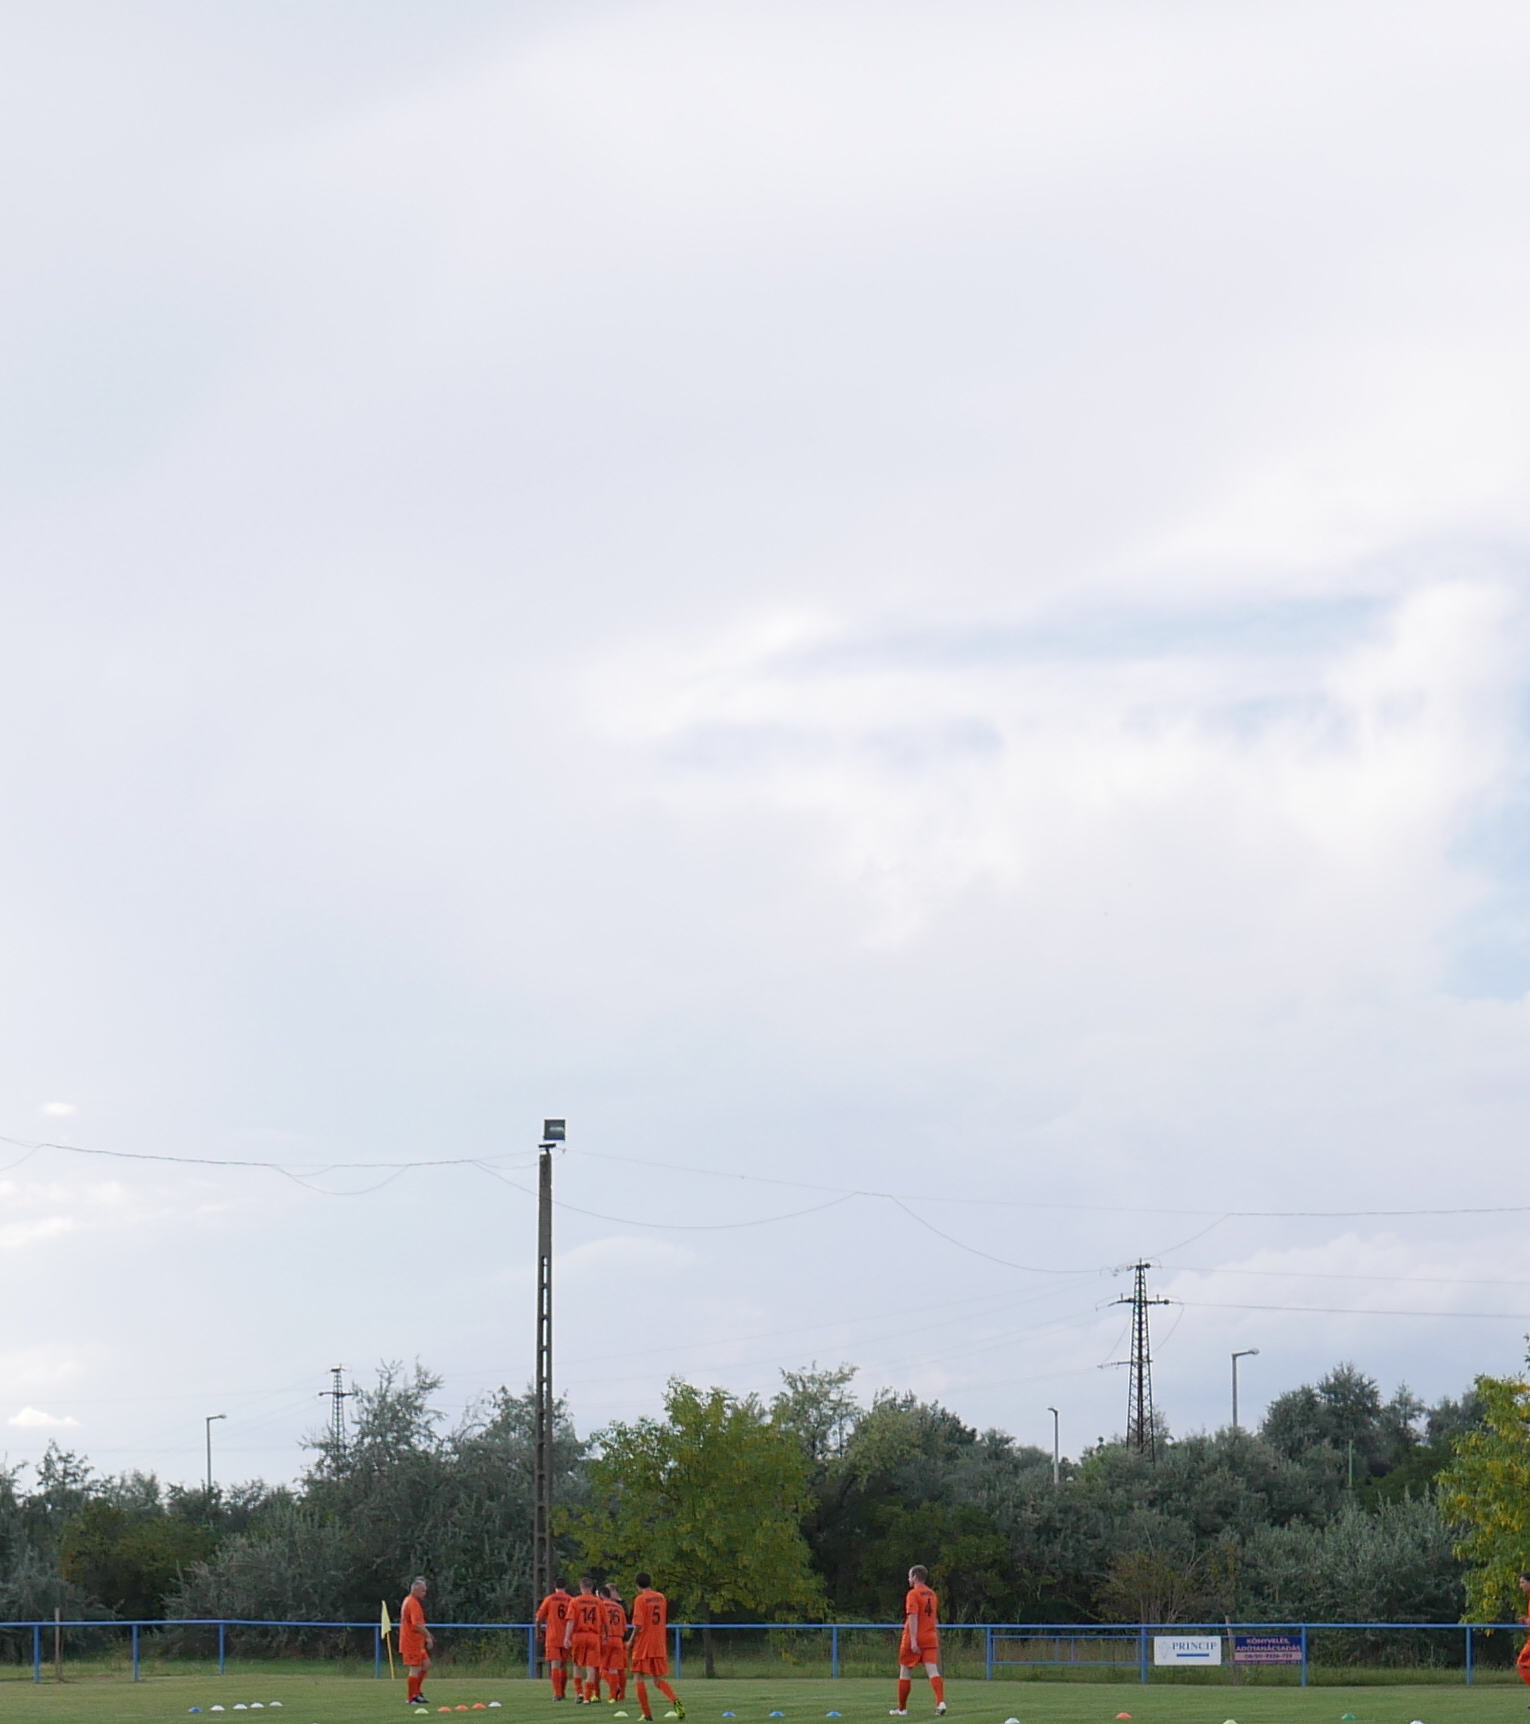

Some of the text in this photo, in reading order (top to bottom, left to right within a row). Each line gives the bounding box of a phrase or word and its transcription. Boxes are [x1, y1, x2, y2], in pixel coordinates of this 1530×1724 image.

[557, 1604, 566, 1619] 6
[581, 1607, 597, 1624] 14
[652, 1605, 661, 1625] 5
[925, 1598, 933, 1617] 4
[608, 1608, 620, 1625] 16
[1172, 1642, 1217, 1650] PRINCIP
